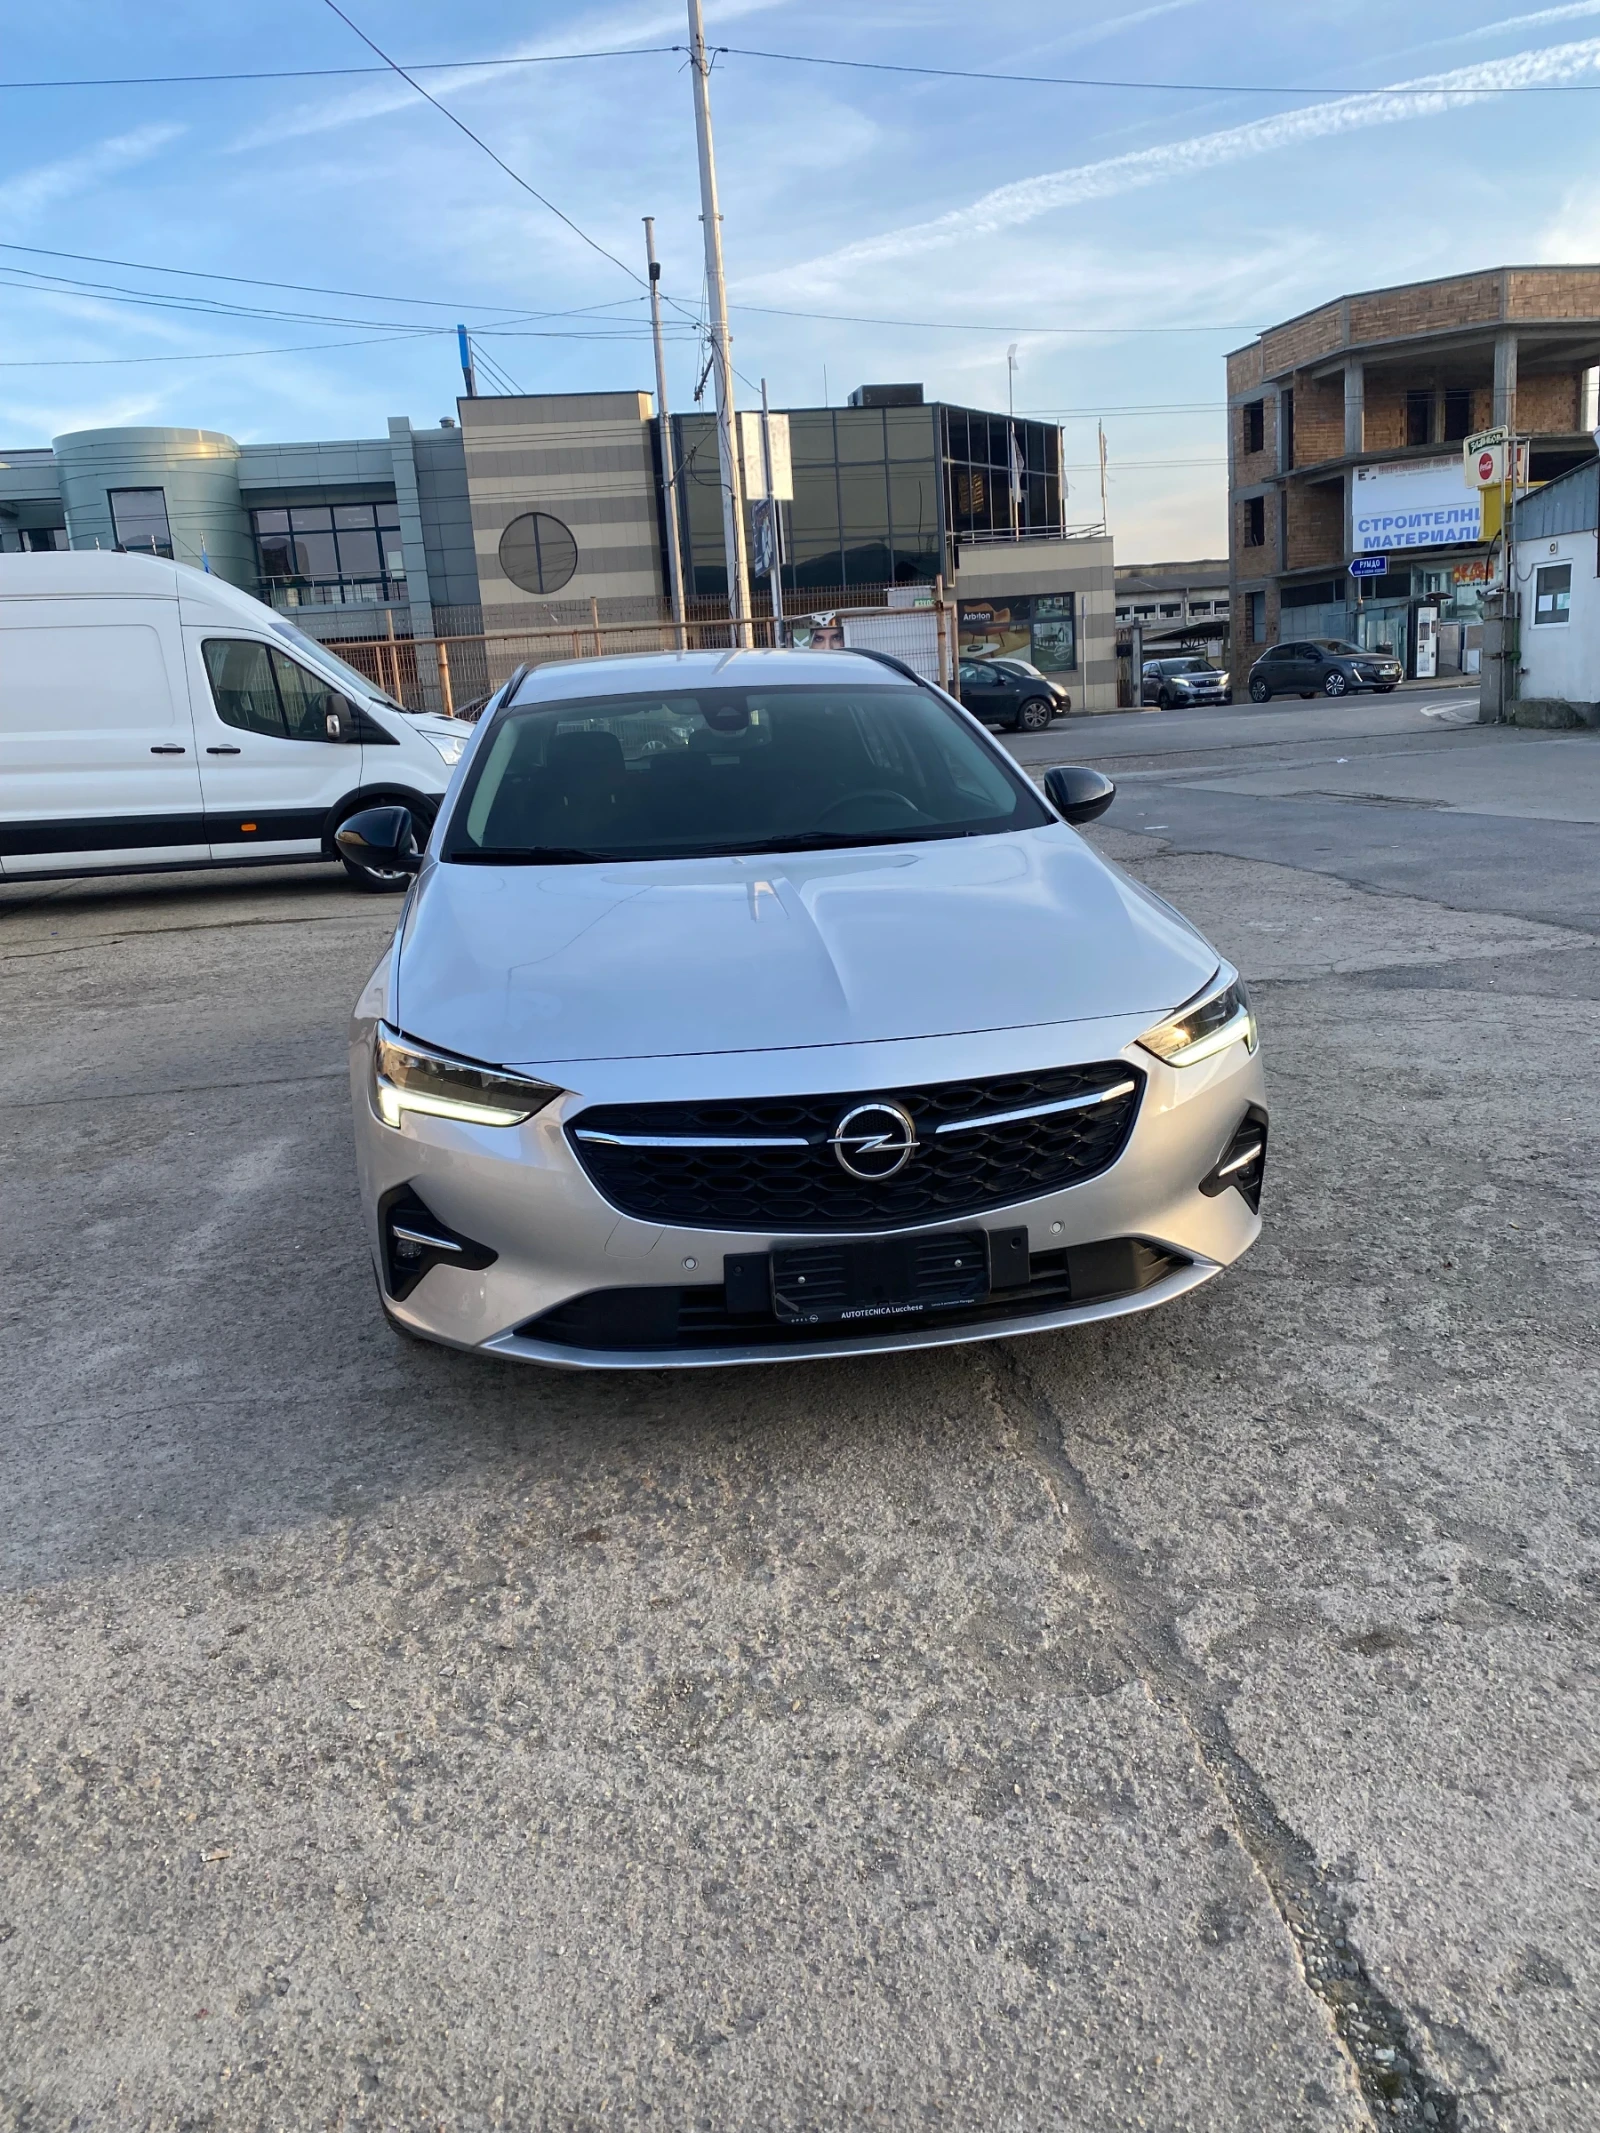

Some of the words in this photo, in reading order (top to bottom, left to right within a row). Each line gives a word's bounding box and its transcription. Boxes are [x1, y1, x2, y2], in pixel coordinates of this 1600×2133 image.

[963, 612, 991, 621] Arbiton
[841, 1307, 891, 1319] AUTOTECNICA
[891, 1304, 923, 1314] Lucchese
